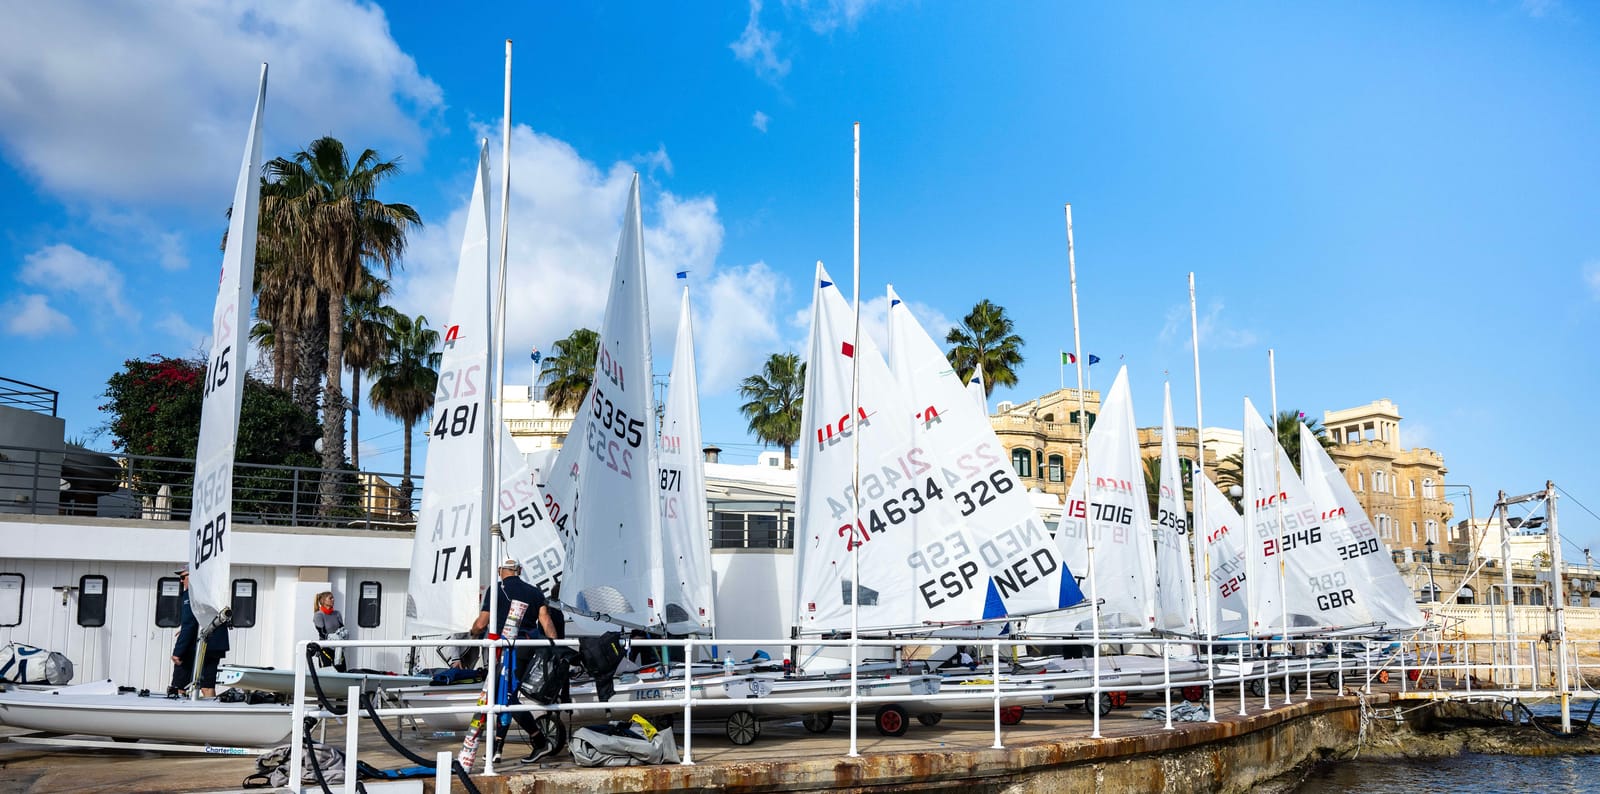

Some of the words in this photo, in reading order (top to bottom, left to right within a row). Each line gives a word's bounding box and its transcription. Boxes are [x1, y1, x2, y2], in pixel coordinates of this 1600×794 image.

[433, 402, 479, 441] 481
[593, 386, 644, 449] 5355
[817, 406, 871, 453] ILCA
[658, 467, 680, 492] 871
[953, 469, 1014, 517] 326
[499, 501, 543, 542] 751
[545, 493, 569, 537] 204
[838, 476, 943, 552] 214634
[1255, 491, 1288, 513] ILCA
[194, 511, 226, 570] GBR
[1263, 526, 1322, 557] 212146
[1337, 537, 1379, 561] 2220
[432, 544, 473, 585] ITA
[918, 560, 979, 609] ESP
[994, 548, 1057, 599] NED
[1316, 588, 1356, 612] GBR
[635, 688, 661, 700] ILCA
